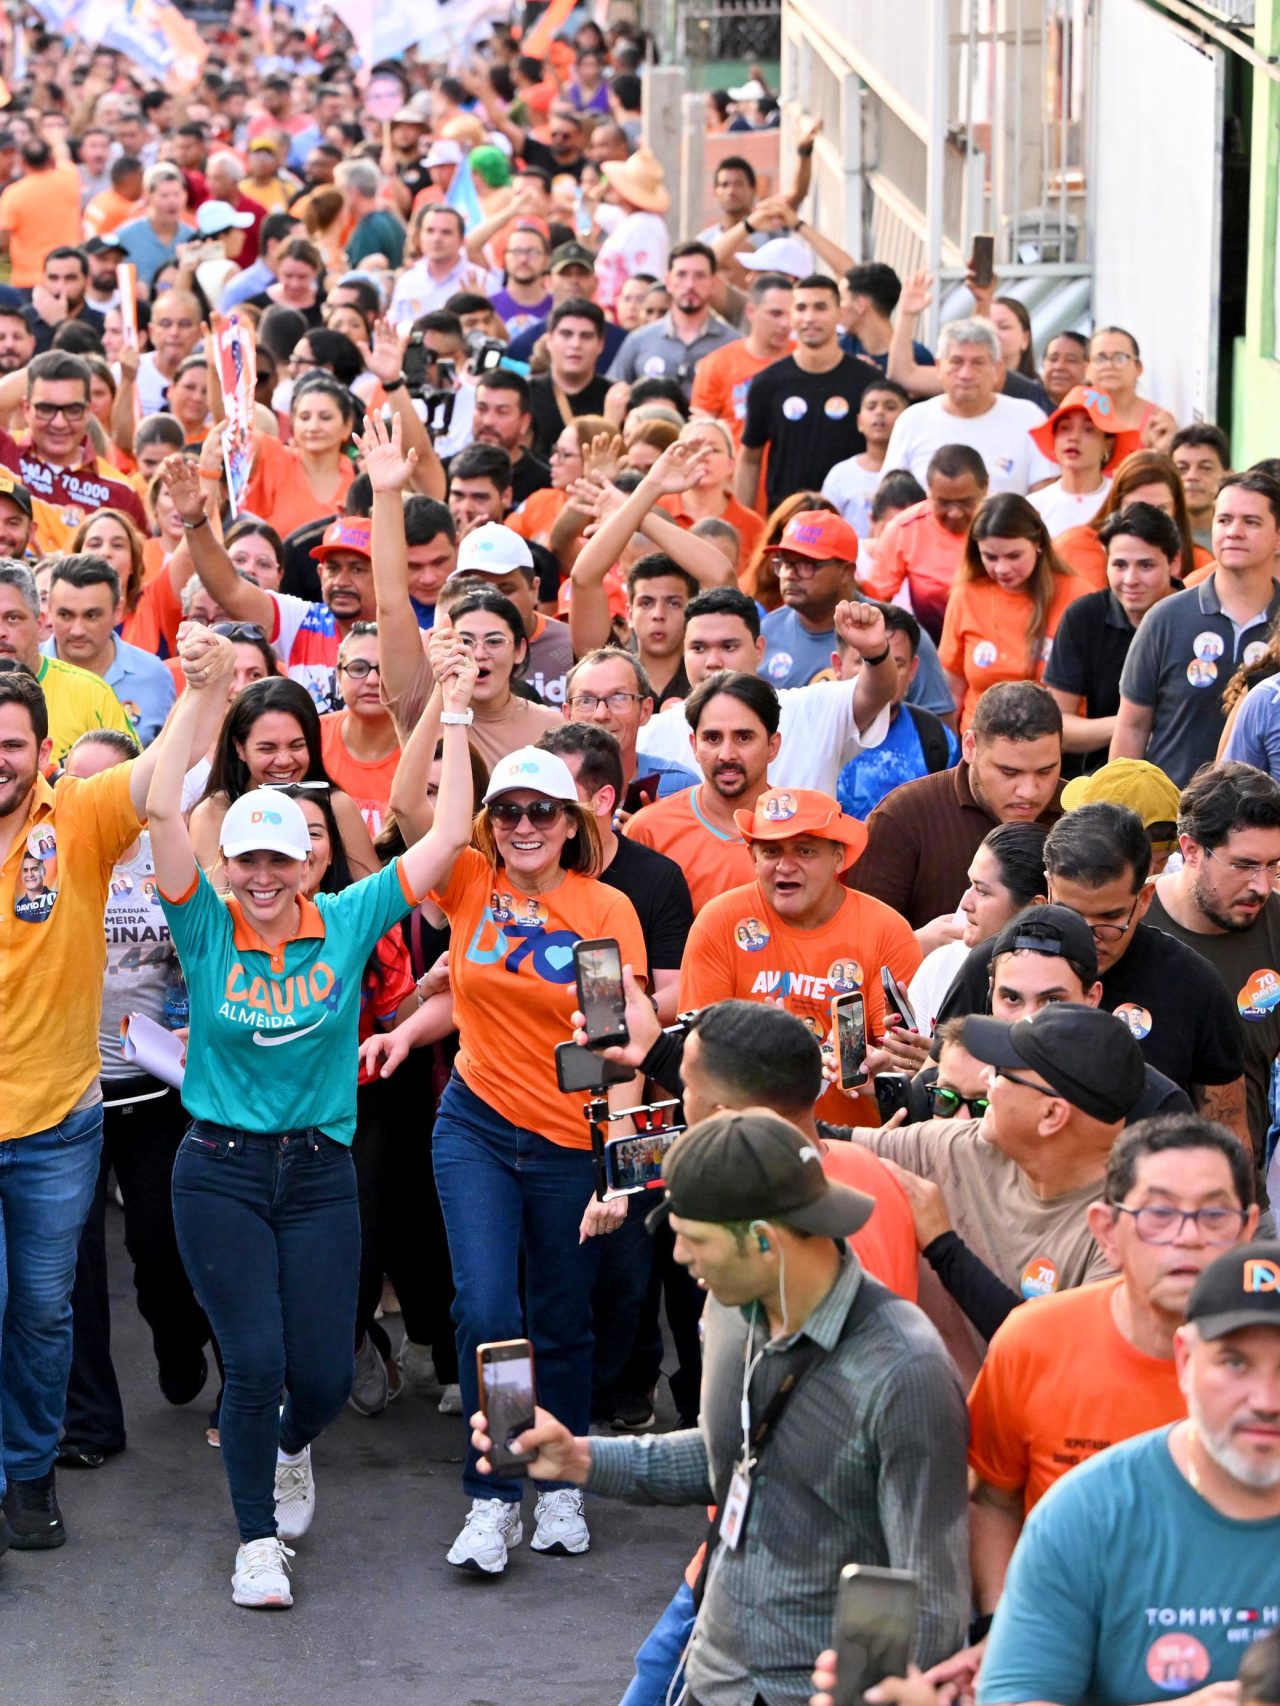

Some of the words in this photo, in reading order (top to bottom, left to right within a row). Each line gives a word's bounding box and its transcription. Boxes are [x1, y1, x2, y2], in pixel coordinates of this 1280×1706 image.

[1083, 388, 1112, 417] 70
[61, 474, 110, 501] 70.000
[525, 672, 567, 703] id
[251, 810, 283, 826] D70
[16, 902, 39, 912] DAVID
[36, 892, 57, 907] 70
[107, 907, 151, 915] ESTADUAL
[1255, 972, 1276, 989] 70
[1251, 982, 1280, 1001] DAVID
[218, 1002, 297, 1029] ALMEIDA
[1037, 1266, 1056, 1284] 70
[1144, 1607, 1233, 1627] TOMMY
